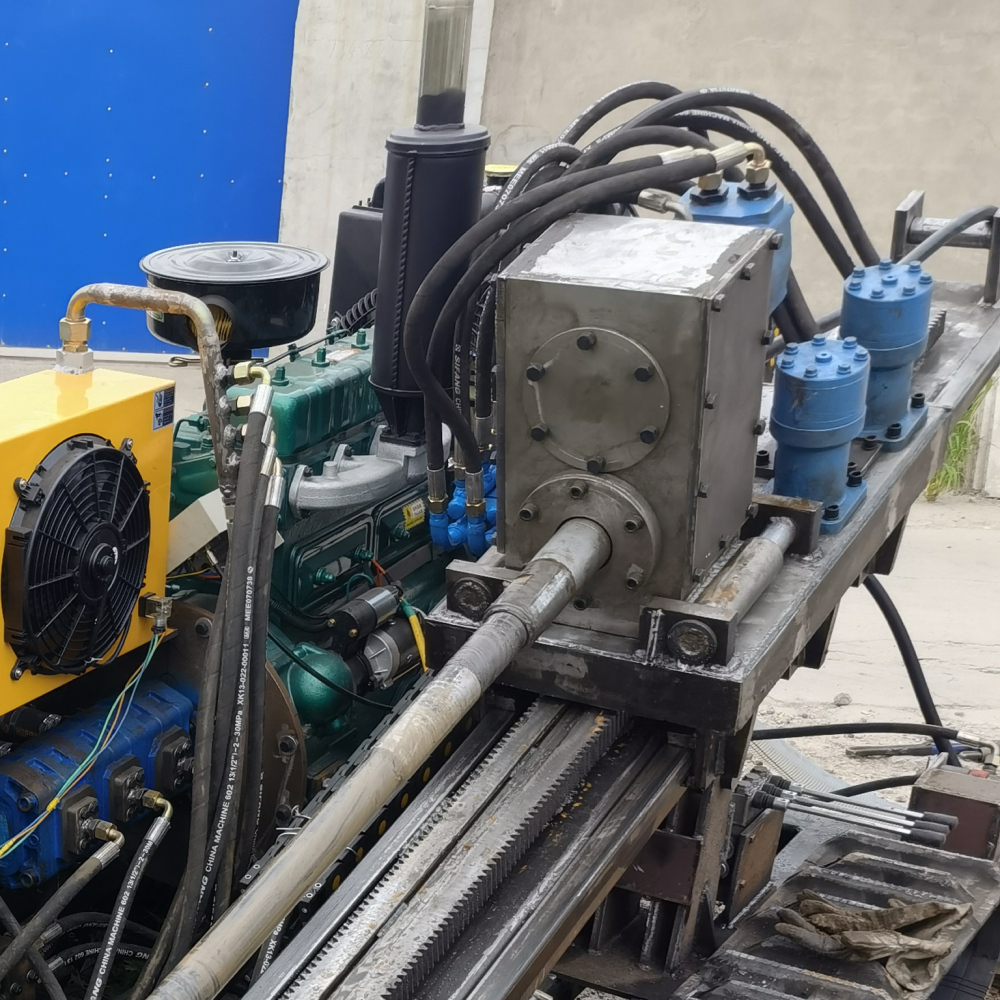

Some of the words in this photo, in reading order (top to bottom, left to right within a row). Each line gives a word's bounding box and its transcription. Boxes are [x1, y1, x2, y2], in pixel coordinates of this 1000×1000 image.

[205, 844, 218, 873] CHINA
[214, 801, 231, 844] MACHINE
[224, 784, 235, 801] 602
[244, 576, 254, 622] MEE070738
[100, 946, 113, 975] CHINA
[108, 906, 126, 946] MACHINE
[120, 891, 131, 906] 602
